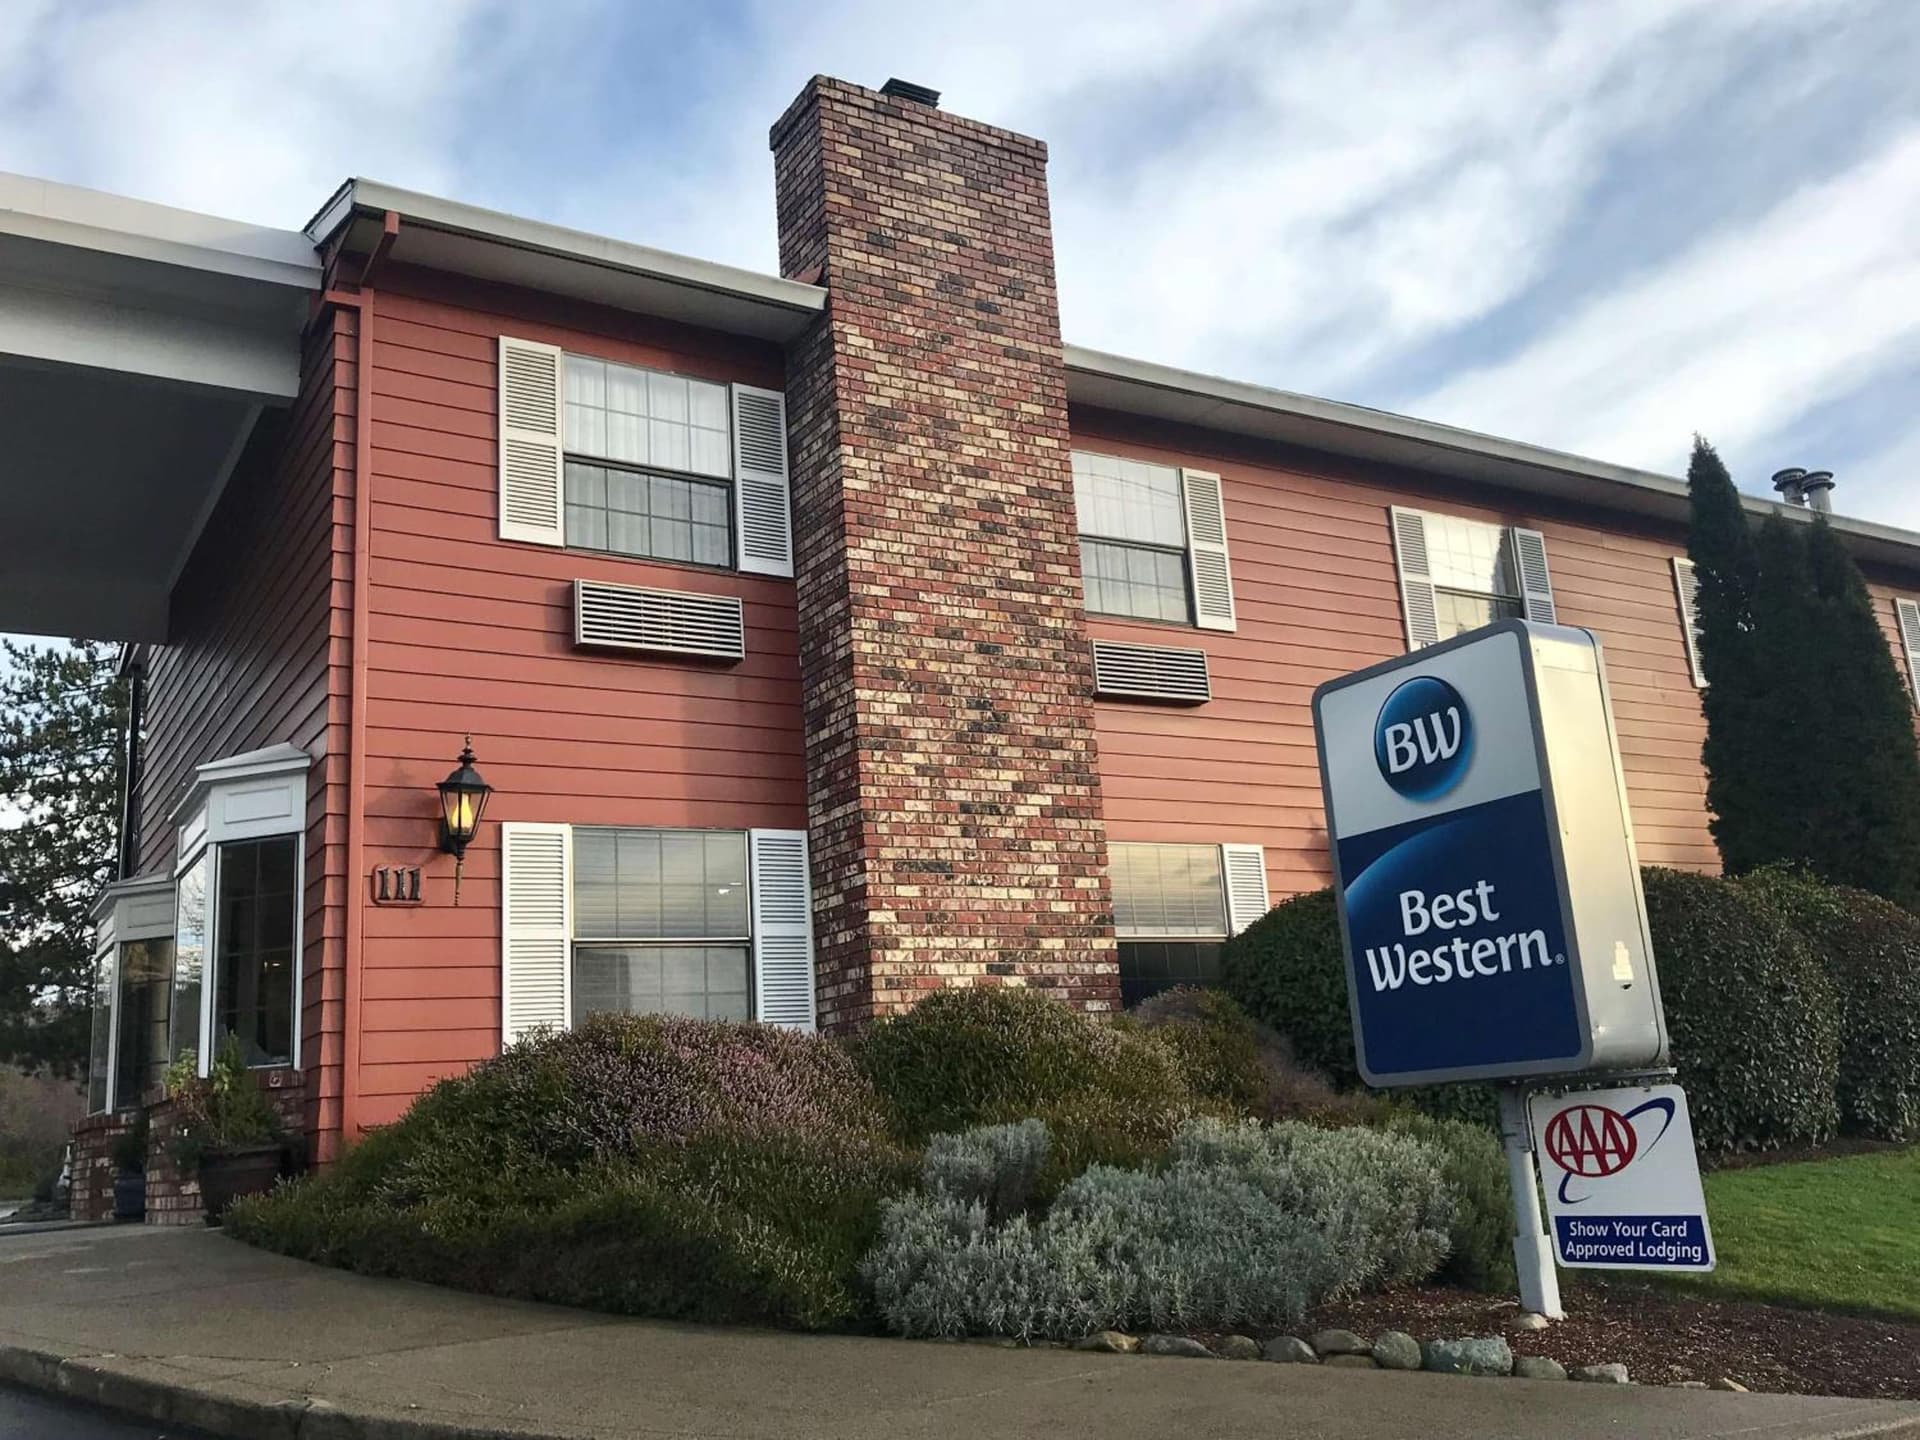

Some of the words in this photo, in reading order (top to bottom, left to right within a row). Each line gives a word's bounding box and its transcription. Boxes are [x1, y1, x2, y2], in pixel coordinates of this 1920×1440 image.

[1384, 706, 1462, 774] BW
[376, 866, 421, 901] 111
[1400, 880, 1500, 936] Best
[1556, 1107, 1630, 1175] AAA
[1566, 1241, 1635, 1260] Approved
[1639, 1242, 1702, 1262] Lodging
[1569, 1221, 1608, 1237] Show
[1613, 1221, 1647, 1237] Your
[1651, 1221, 1688, 1238] Card
